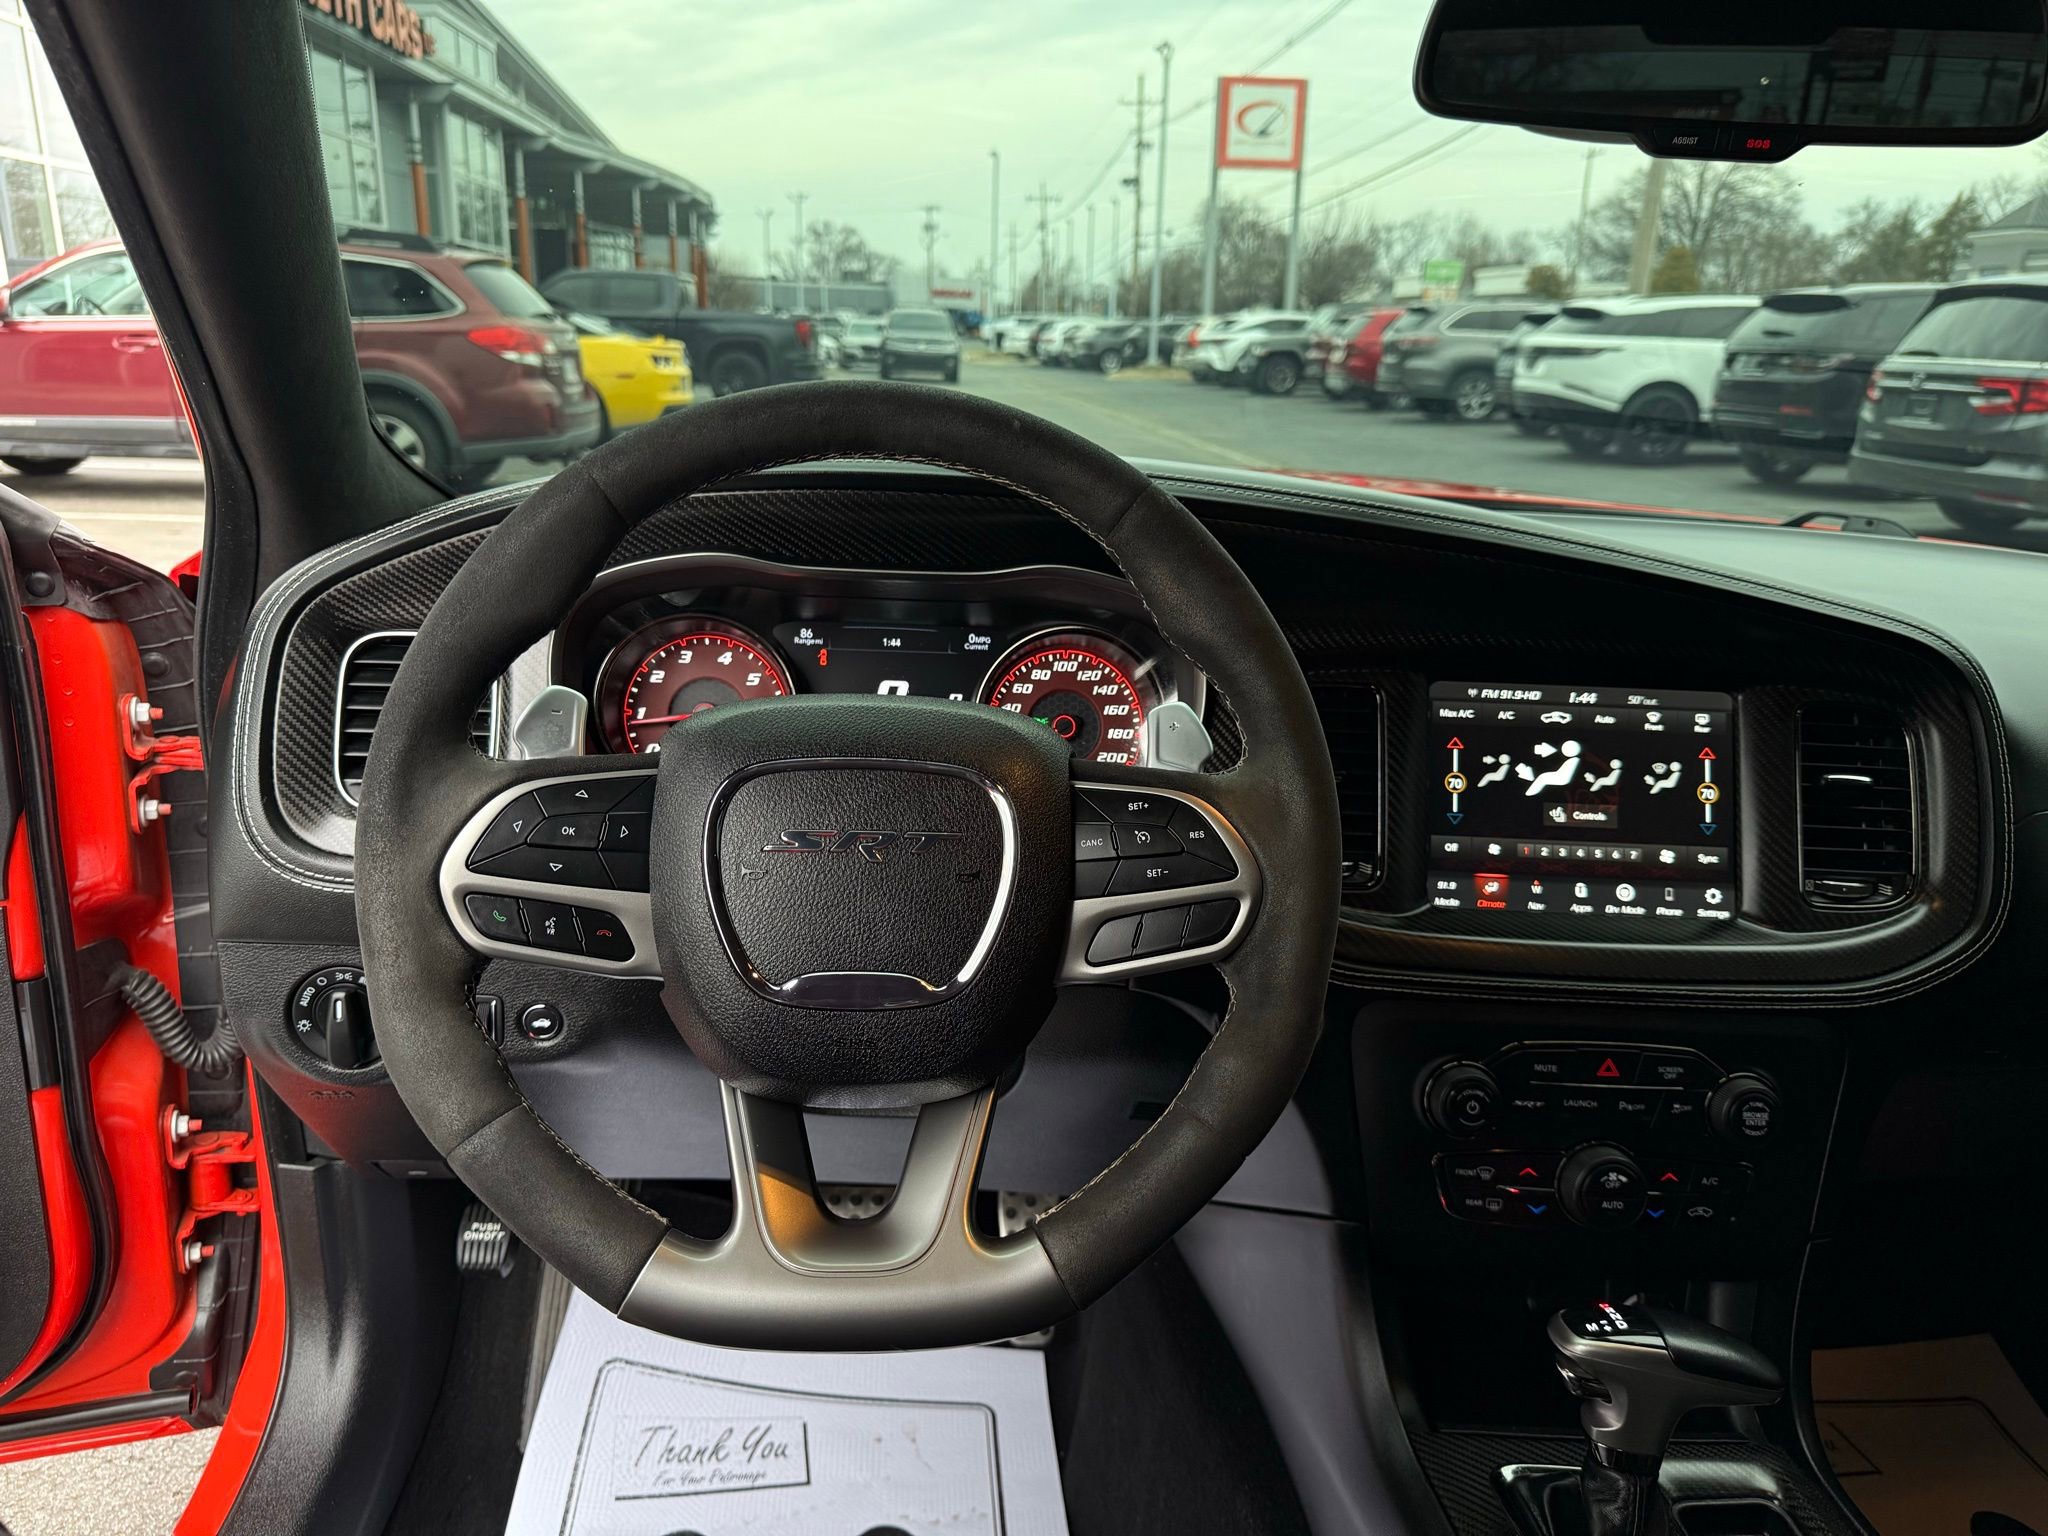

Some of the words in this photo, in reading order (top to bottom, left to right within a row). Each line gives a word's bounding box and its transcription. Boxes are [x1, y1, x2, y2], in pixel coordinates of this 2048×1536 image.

[1672, 136, 1698, 145] ASSIST
[1746, 138, 1771, 149] SOS
[799, 627, 814, 639] 86
[882, 637, 902, 648] 1:44
[963, 643, 989, 651] Current
[677, 650, 693, 664] 3
[717, 651, 733, 666] 4
[1052, 660, 1079, 673] 100
[649, 670, 666, 684] 2
[746, 672, 762, 686] 5
[1030, 669, 1052, 681] 80
[1077, 669, 1103, 681] 120
[1012, 683, 1034, 695] 60
[1092, 684, 1119, 696] 140
[1481, 688, 1499, 699] FM
[1569, 691, 1598, 704] 1:44
[636, 706, 647, 720] 1
[1103, 704, 1130, 716] 160
[1439, 708, 1458, 718] Max
[1458, 709, 1476, 719] A/C
[1497, 711, 1516, 720] A/C
[1594, 714, 1617, 724] Auto
[1107, 728, 1134, 740] 180
[1096, 752, 1128, 763] 200
[1448, 777, 1463, 789] 70
[1700, 787, 1715, 800] 70
[561, 825, 576, 837] OK
[1189, 830, 1205, 840] RES
[762, 829, 963, 863] SRT
[1080, 837, 1104, 848] CANC
[1444, 843, 1459, 853] Off
[1523, 846, 1531, 856] 1
[1540, 846, 1550, 857] 2
[1558, 847, 1568, 857] 3
[1576, 848, 1586, 858] 4
[1594, 849, 1603, 859] 5
[1611, 850, 1621, 859] 6
[1629, 850, 1639, 860] 7
[1698, 853, 1720, 864] Sync
[1476, 899, 1507, 909] Climate
[299, 985, 316, 1007] AUTO
[1533, 1063, 1559, 1074] MUTE
[1563, 1098, 1599, 1108] LAUNCH
[1742, 1111, 1770, 1119] BROWSE
[1745, 1119, 1767, 1127] ENTER
[1455, 1168, 1477, 1177] FRONT
[1604, 1180, 1622, 1189] OFF
[1701, 1176, 1721, 1186] A/C
[1465, 1198, 1484, 1207] REAR
[1601, 1200, 1625, 1210] AUTO
[470, 1222, 502, 1232] PUSH
[1585, 1322, 1600, 1332] M
[1615, 1320, 1629, 1330] D
[634, 1424, 734, 1467] Thank
[742, 1423, 789, 1464] You
